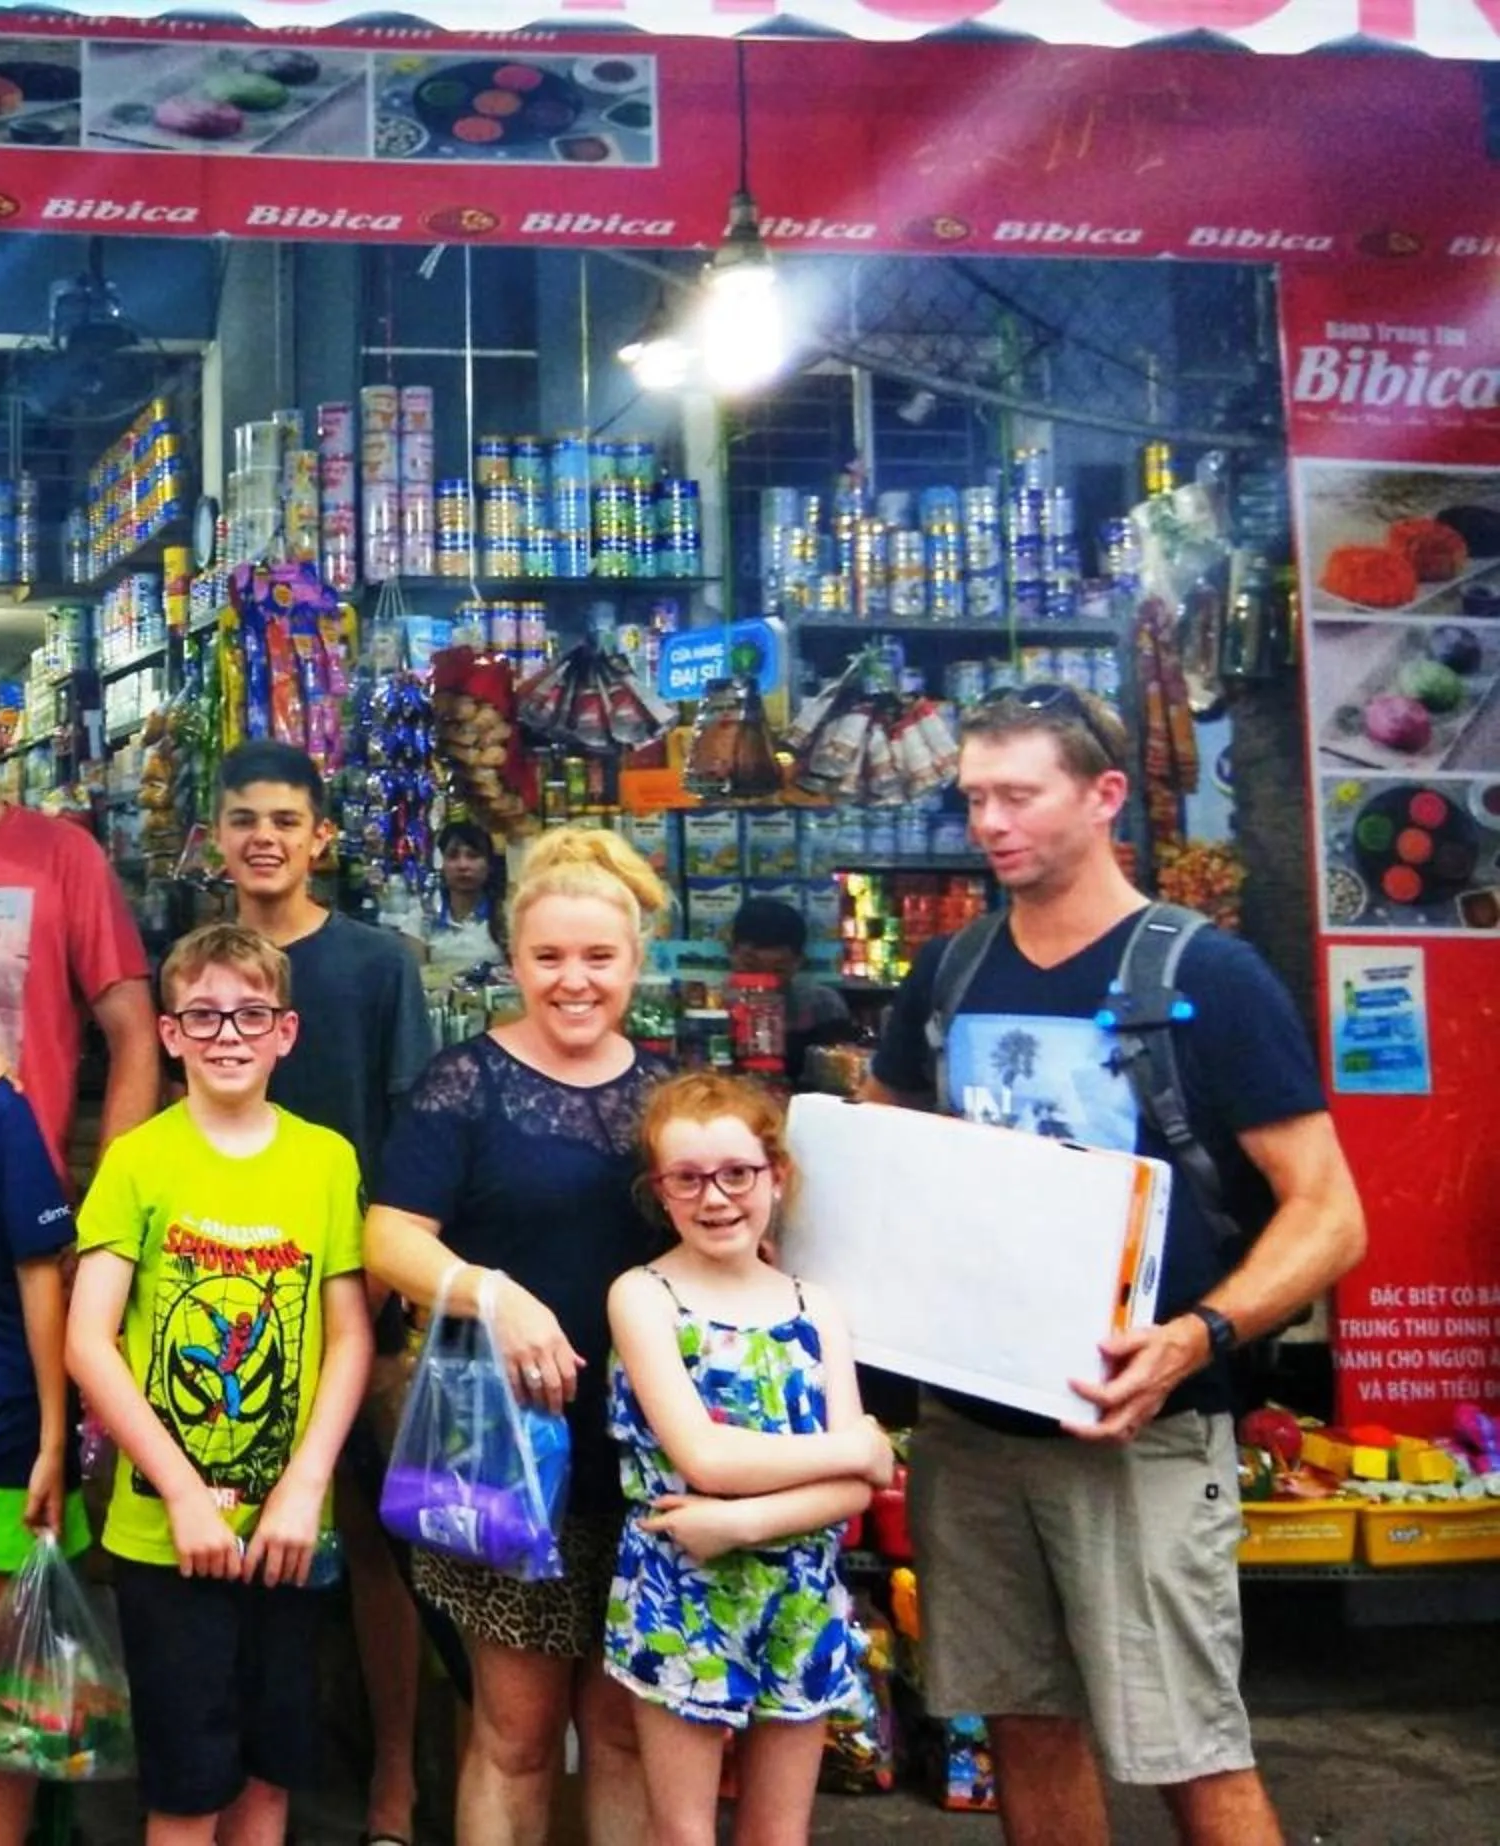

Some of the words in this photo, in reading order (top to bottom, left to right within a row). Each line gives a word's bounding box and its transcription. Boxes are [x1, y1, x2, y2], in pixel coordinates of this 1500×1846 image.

[42, 197, 199, 223] Bibica
[245, 204, 403, 231] Bibica
[520, 212, 676, 237] Bibica
[724, 216, 877, 241] ibica
[993, 220, 1144, 245] Bibica
[1186, 225, 1333, 251] Bibica
[1294, 345, 1500, 410] Bibica
[1339, 1318, 1400, 1338] TRUNG
[1405, 1318, 1440, 1337] THU
[1444, 1317, 1491, 1337] DINH
[1386, 1349, 1424, 1369] CHO
[1358, 1377, 1383, 1400] VÀ
